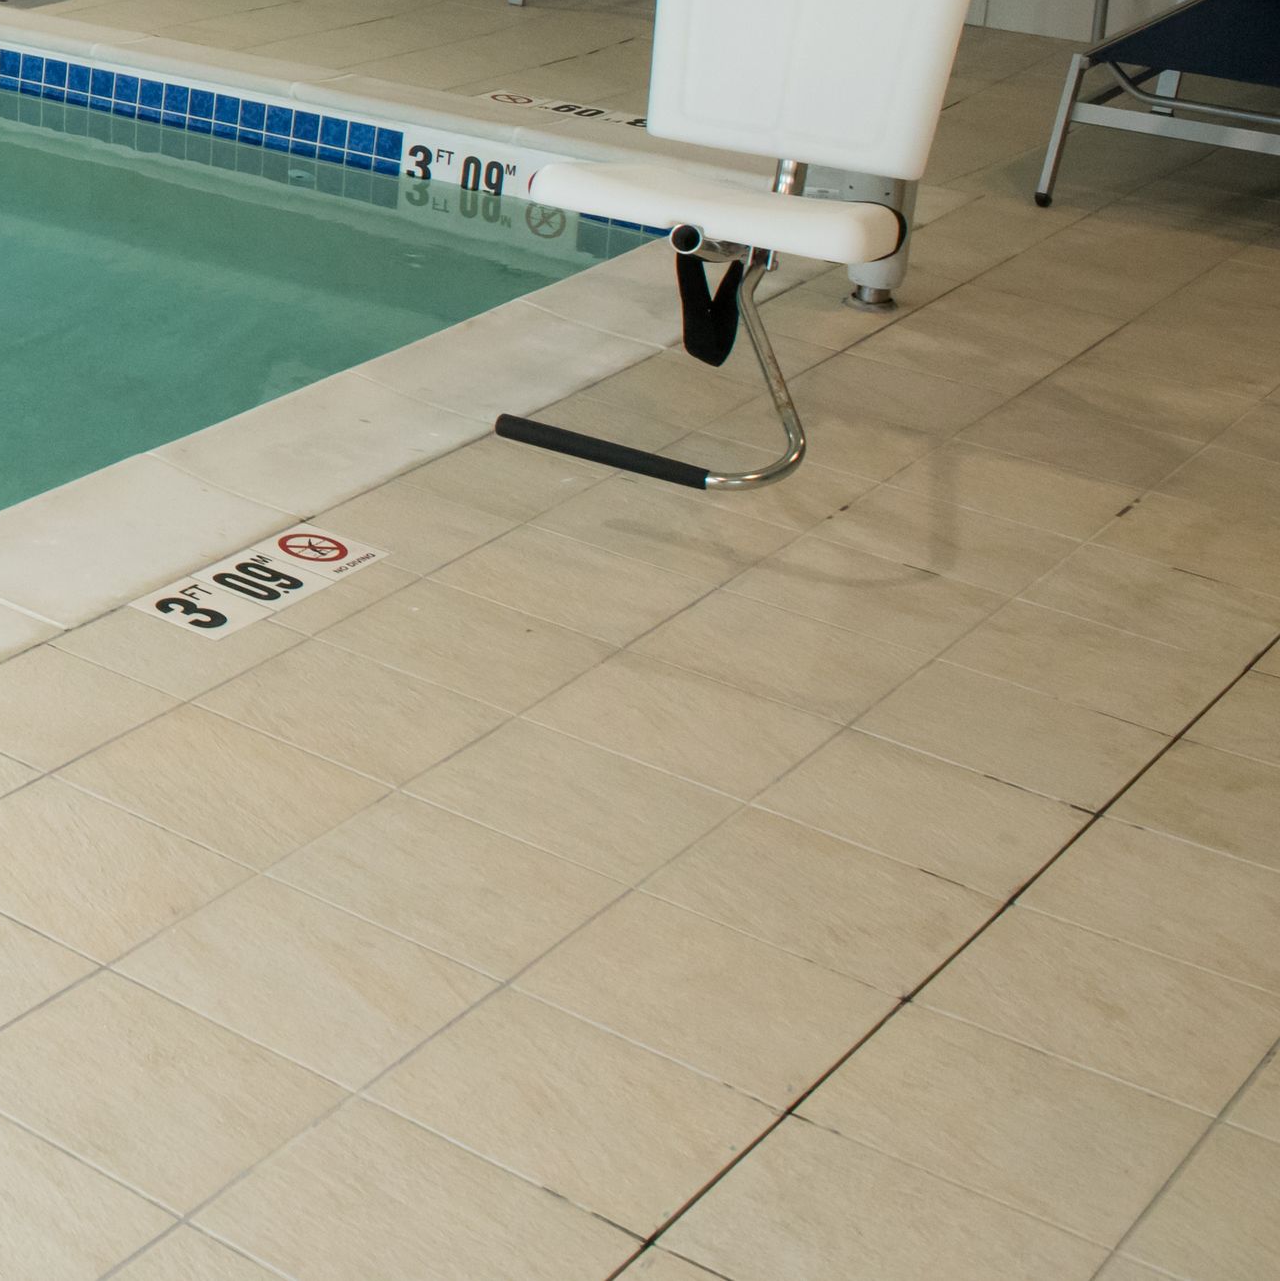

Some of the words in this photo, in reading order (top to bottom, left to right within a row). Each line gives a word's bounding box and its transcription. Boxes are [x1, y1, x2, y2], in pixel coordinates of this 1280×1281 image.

[406, 144, 432, 180] 3
[436, 148, 455, 165] FT
[460, 155, 504, 196] 09
[505, 163, 517, 177] M
[250, 554, 273, 565] M
[179, 584, 212, 601] FT
[155, 597, 228, 629] 3
